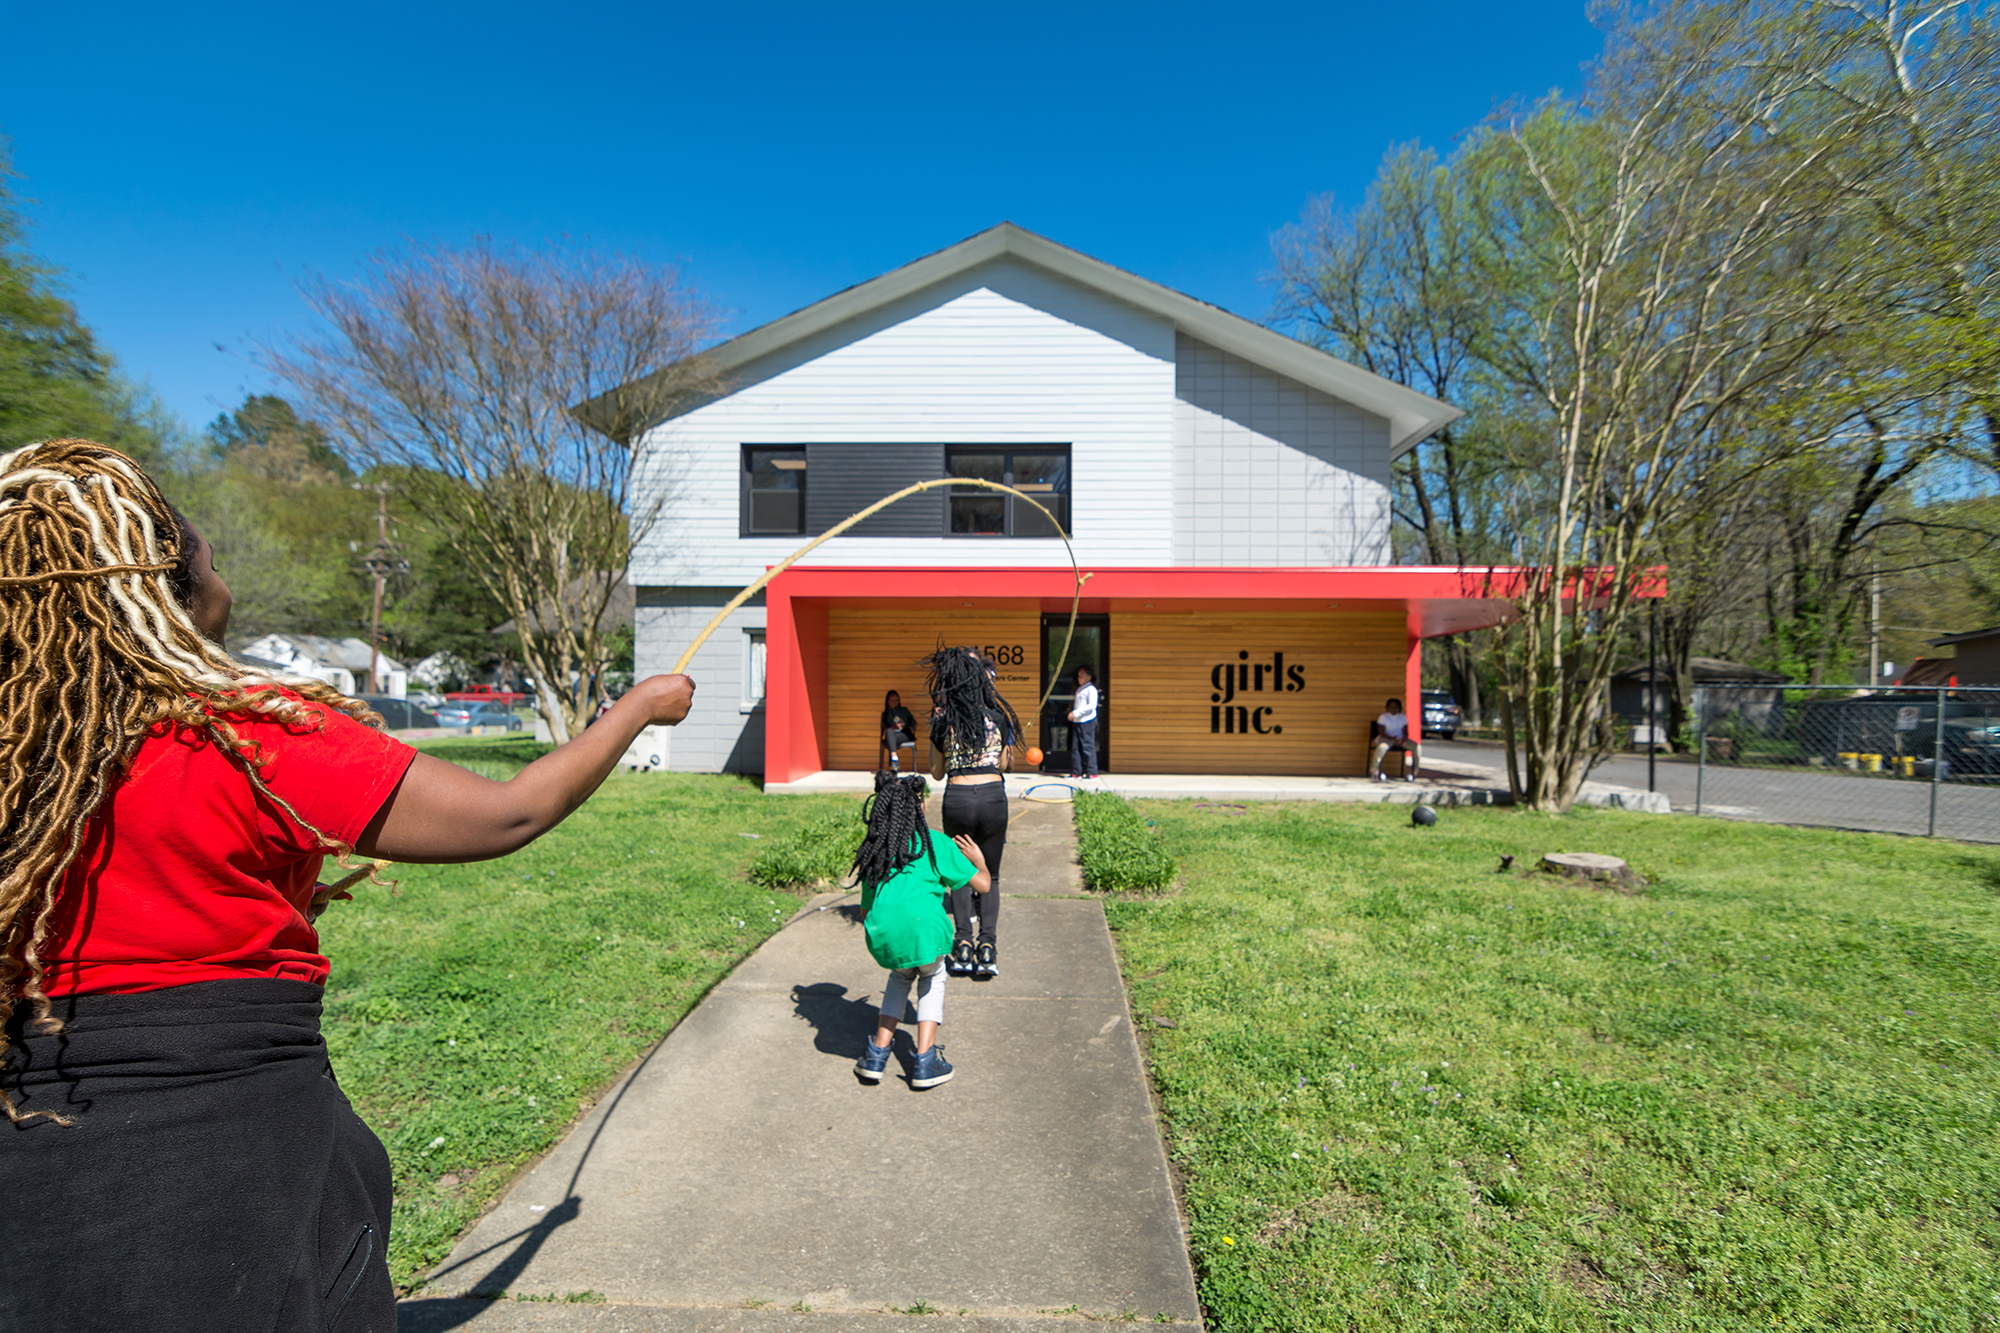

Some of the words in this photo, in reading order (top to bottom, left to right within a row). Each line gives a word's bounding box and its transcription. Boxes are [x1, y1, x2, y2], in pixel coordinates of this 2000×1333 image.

[974, 645, 1024, 665] 568
[1210, 650, 1306, 704] girls
[1210, 705, 1283, 734] inc.
